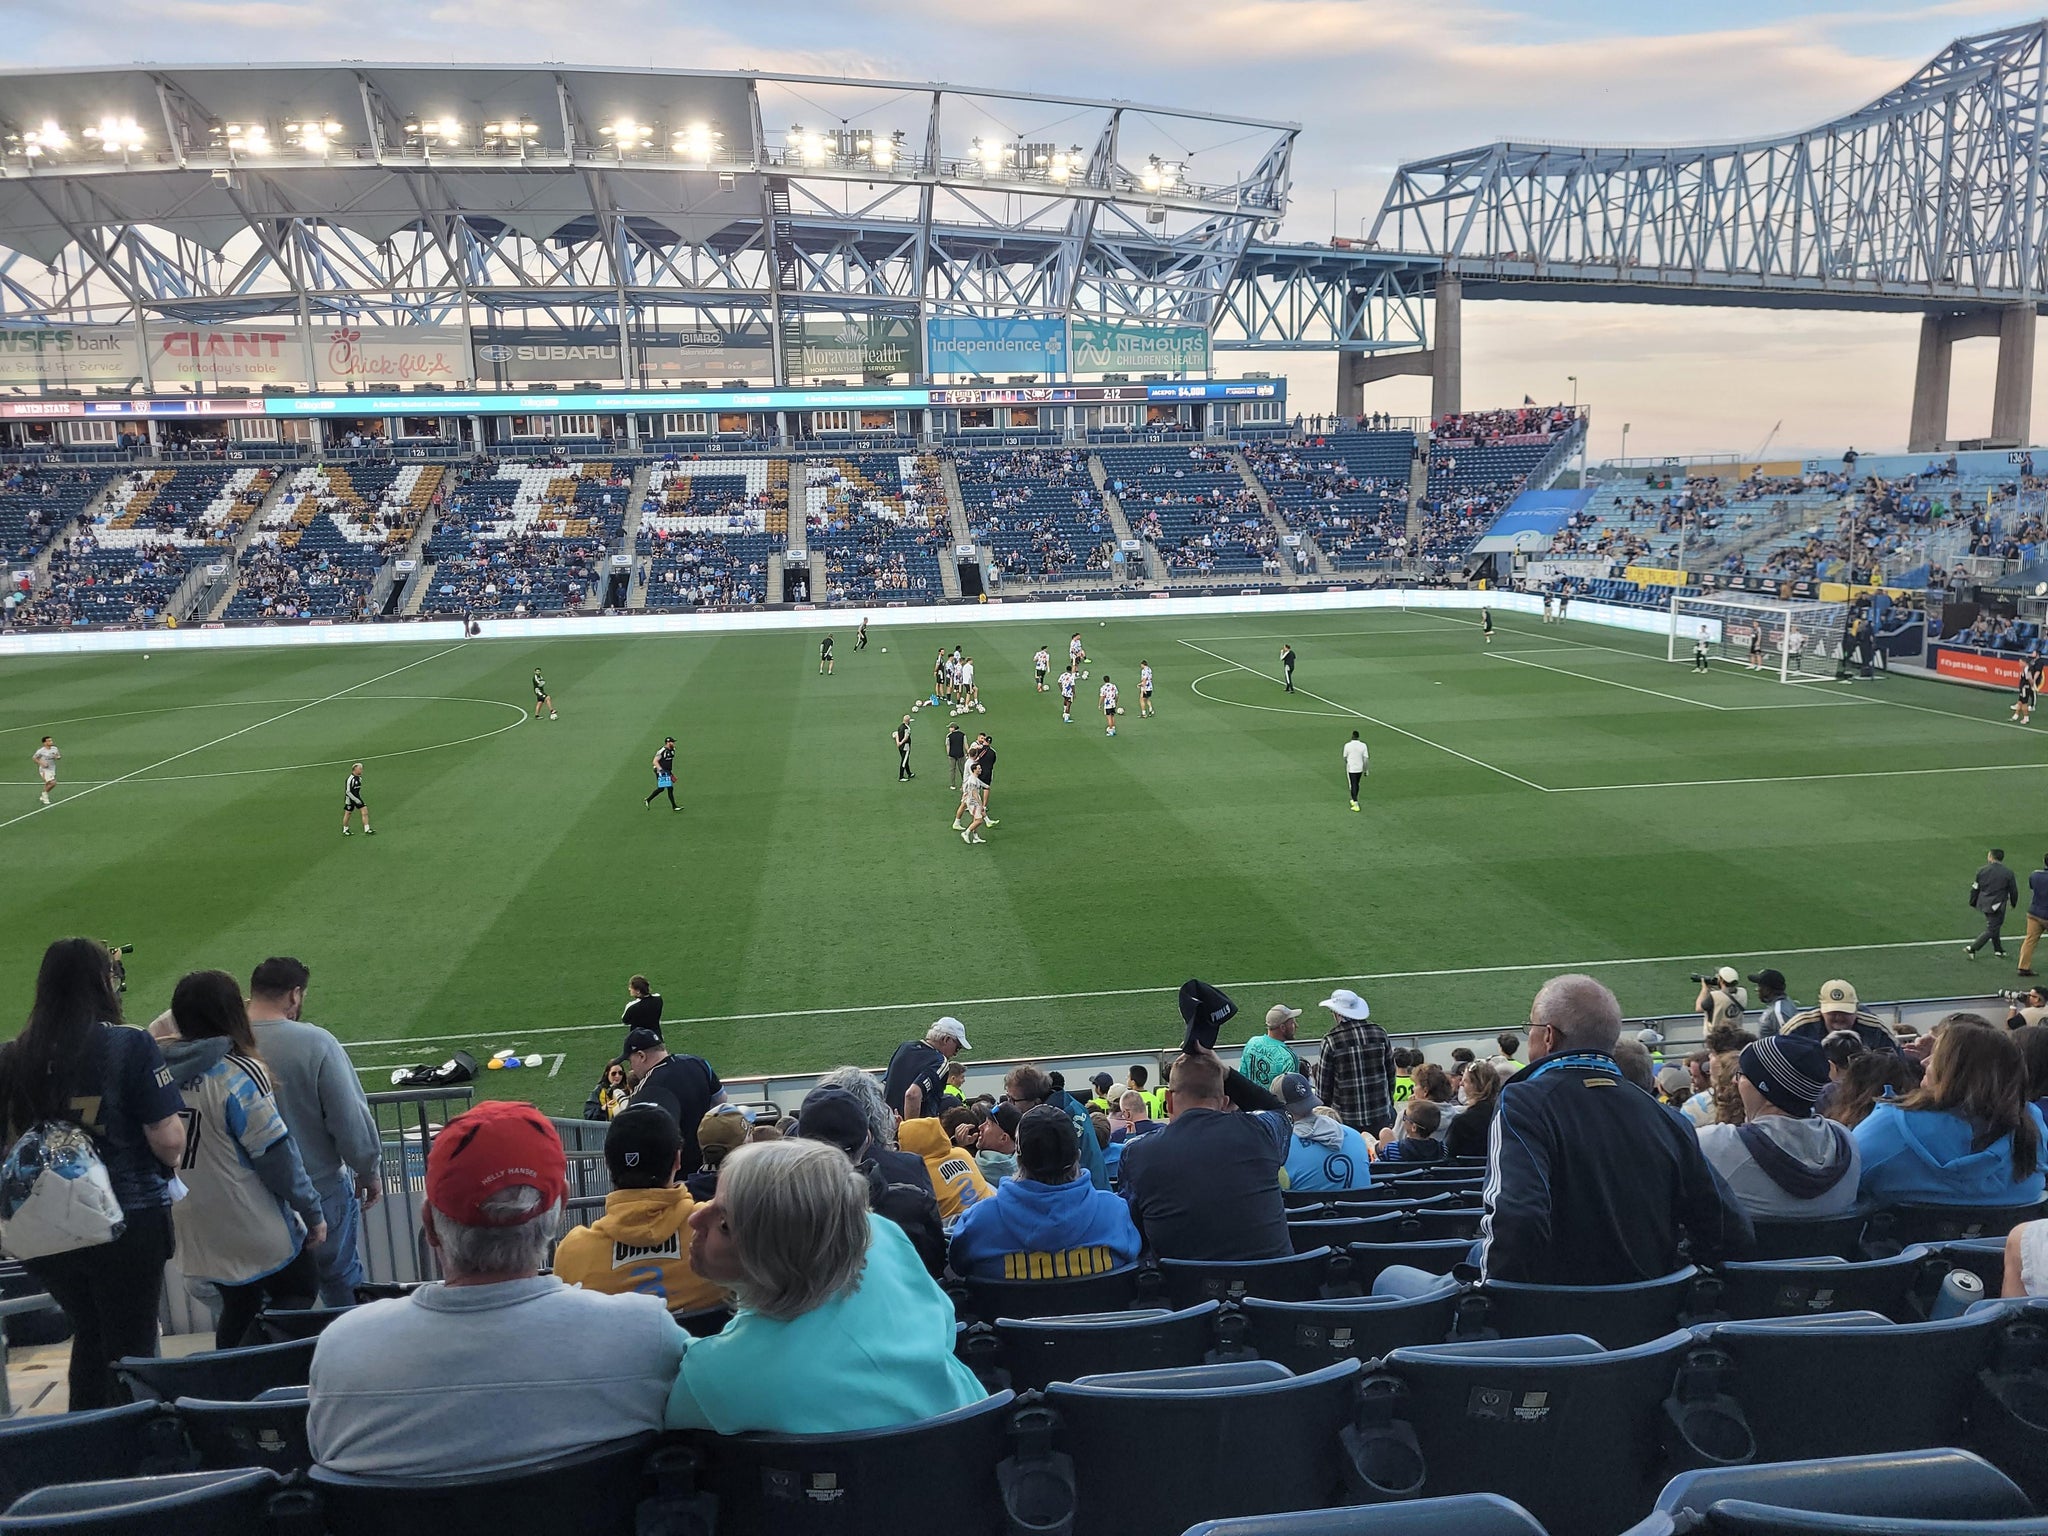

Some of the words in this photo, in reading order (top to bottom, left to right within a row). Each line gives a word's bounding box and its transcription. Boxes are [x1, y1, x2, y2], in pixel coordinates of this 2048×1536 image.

[78, 335, 120, 350] bank
[163, 331, 286, 357] GIANT
[681, 333, 720, 344] BIMBO
[932, 337, 1042, 355] Independence
[1116, 338, 1203, 352] NEMOURS
[328, 338, 453, 378] Chick-fil-A
[517, 345, 617, 360] SUBARU
[1116, 355, 1169, 365] CHILDREN'S
[1172, 354, 1204, 365] HEALTH
[16, 362, 51, 373] Stand
[55, 361, 73, 372] For
[79, 360, 122, 372] Service
[177, 363, 194, 373] for
[197, 362, 241, 375] today's
[245, 363, 276, 373] table
[1103, 389, 1121, 400] 2:12
[44, 404, 71, 413] STATS
[857, 441, 871, 449] 129
[1005, 437, 1018, 445] 130
[1149, 435, 1161, 443] 131
[412, 449, 426, 457] 126
[552, 446, 566, 455] 127
[707, 443, 722, 452] 128
[45, 455, 61, 463] 124
[228, 452, 243, 460] 125
[1249, 1053, 1271, 1085] 18
[940, 1160, 970, 1180] UNION
[1323, 1153, 1354, 1188] 9
[481, 1170, 505, 1186] HELLY
